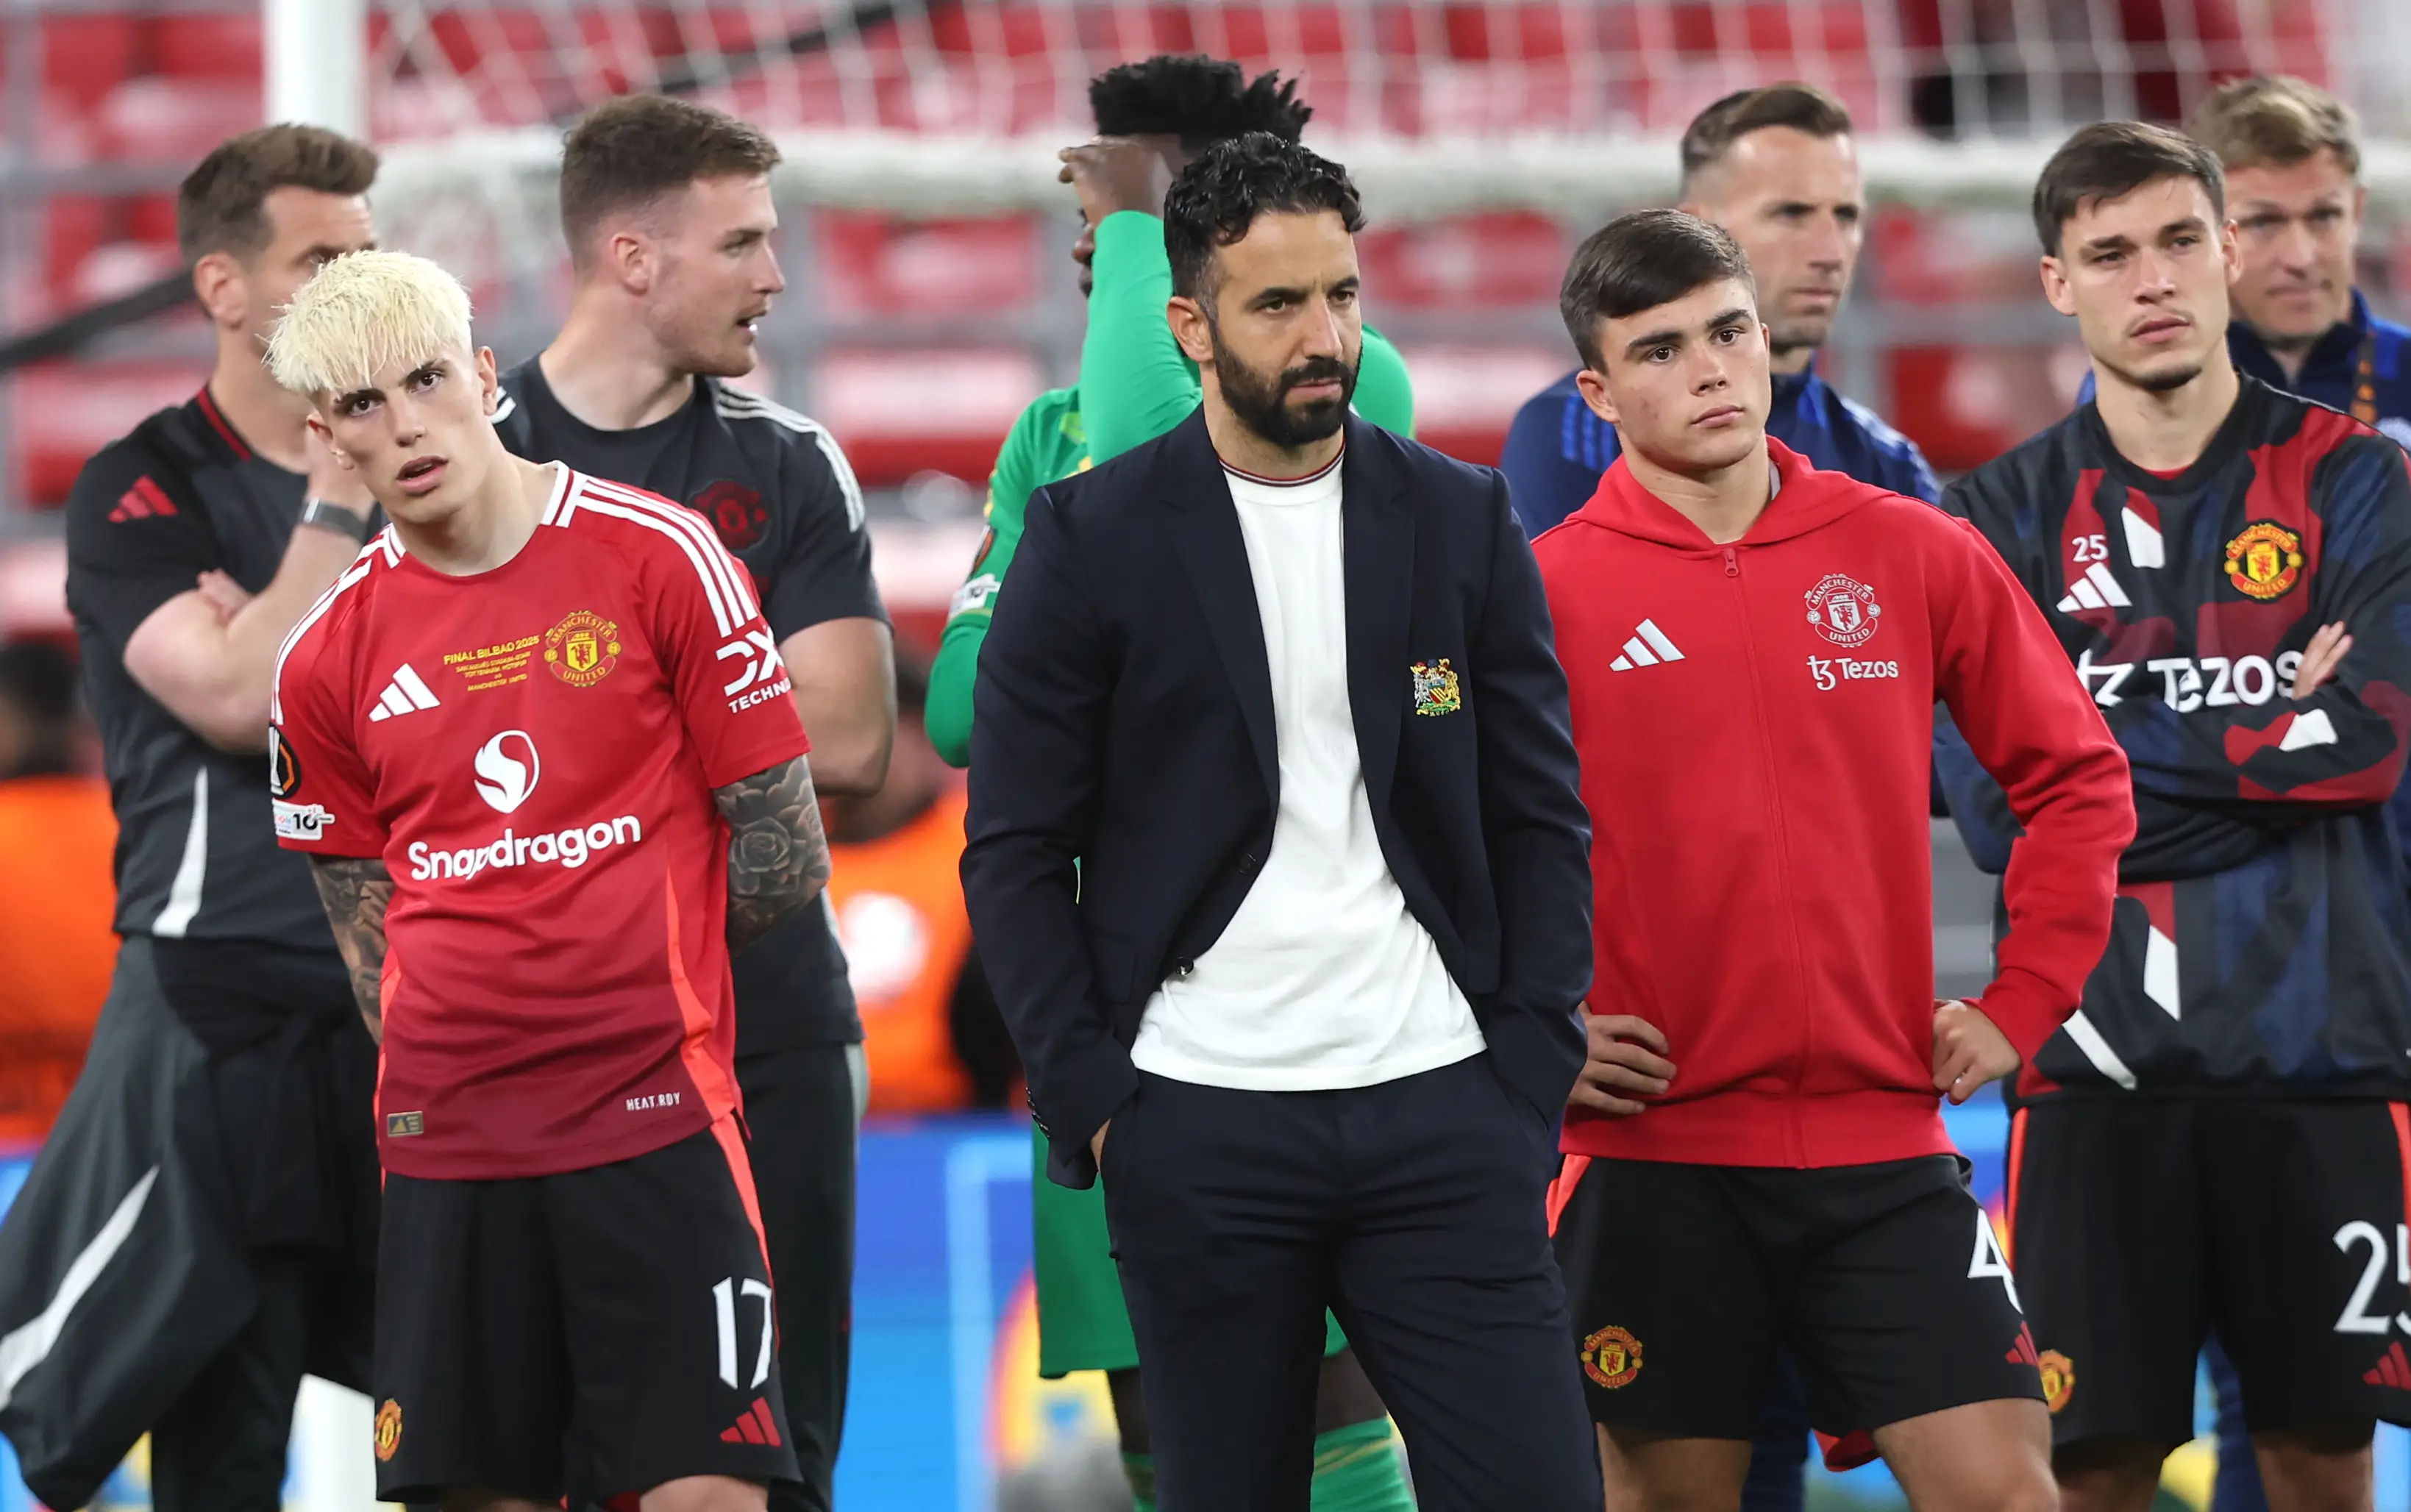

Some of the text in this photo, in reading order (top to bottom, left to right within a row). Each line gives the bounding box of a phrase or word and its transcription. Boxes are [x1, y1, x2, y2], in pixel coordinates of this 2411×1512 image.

[2071, 535, 2109, 562] 25
[1811, 579, 1869, 605] MANCHESTER
[552, 616, 613, 643] MANCHESTER
[1829, 628, 1870, 642] UNITED
[444, 650, 476, 665] FINAL
[477, 642, 515, 659] BILBAO
[515, 635, 540, 650] 2025
[563, 666, 606, 681] UNITED
[1835, 657, 1898, 680] Tezos
[407, 815, 642, 881] Snapdragon
[712, 1276, 773, 1390] 17
